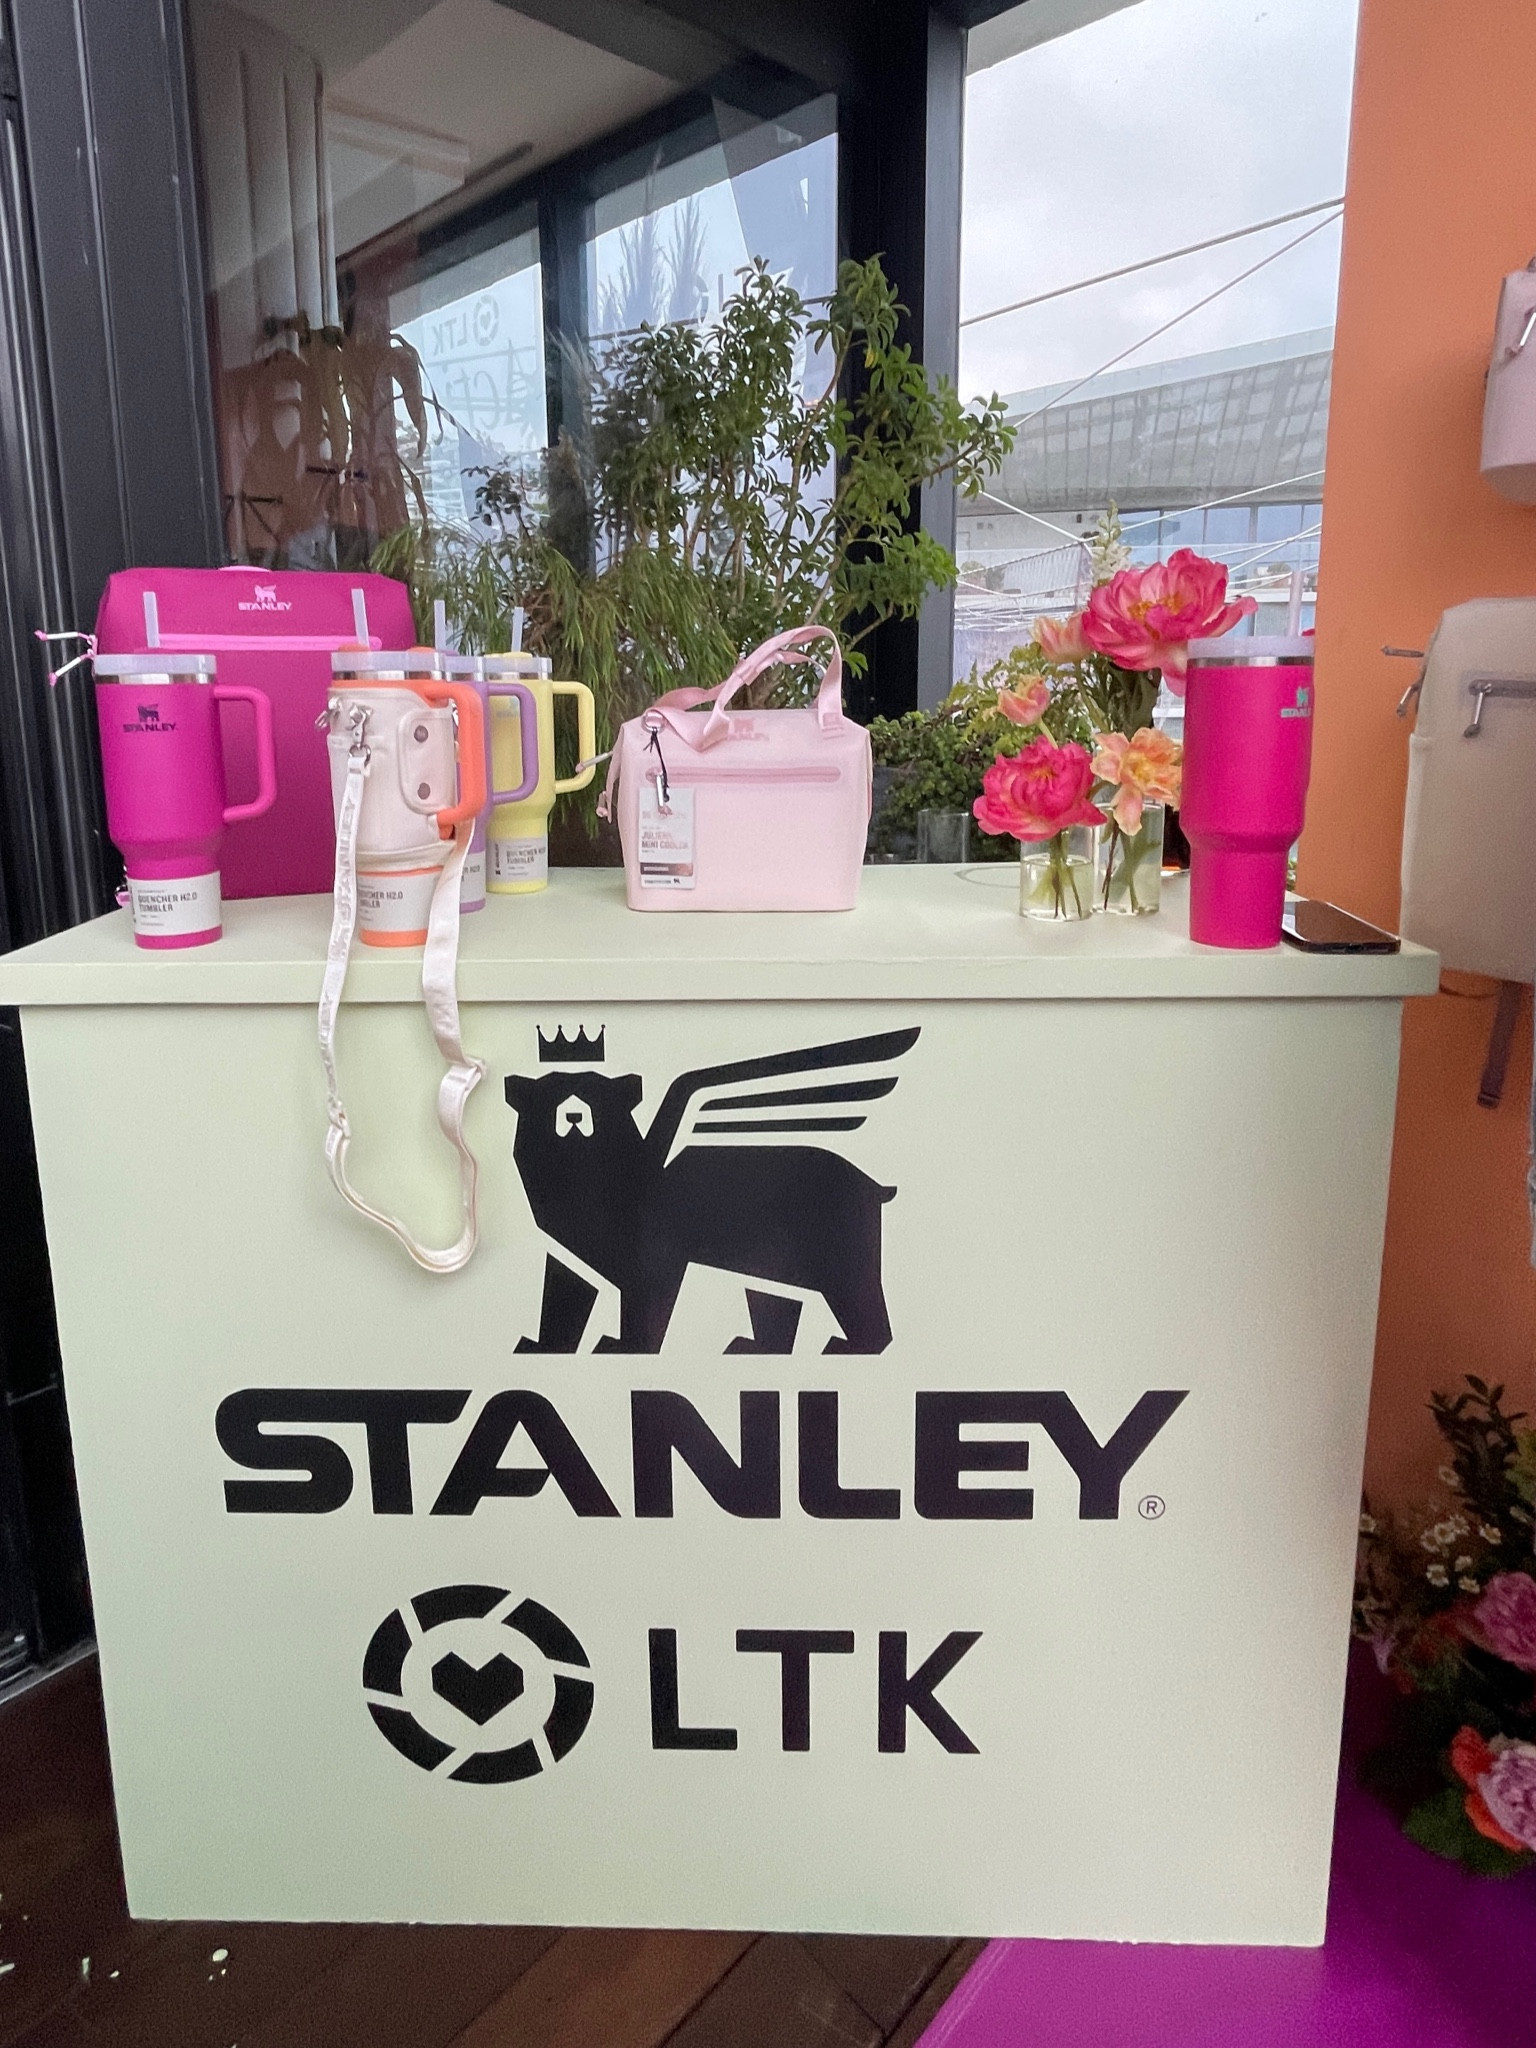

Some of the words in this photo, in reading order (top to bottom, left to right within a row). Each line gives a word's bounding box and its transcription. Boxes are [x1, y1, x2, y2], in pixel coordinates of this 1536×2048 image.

[238, 602, 292, 611] STANLEY
[122, 722, 176, 733] STANLEY
[139, 904, 173, 913] TUMBLER
[215, 1388, 1190, 1520] STANLEY
[649, 1629, 984, 1755] LTK
